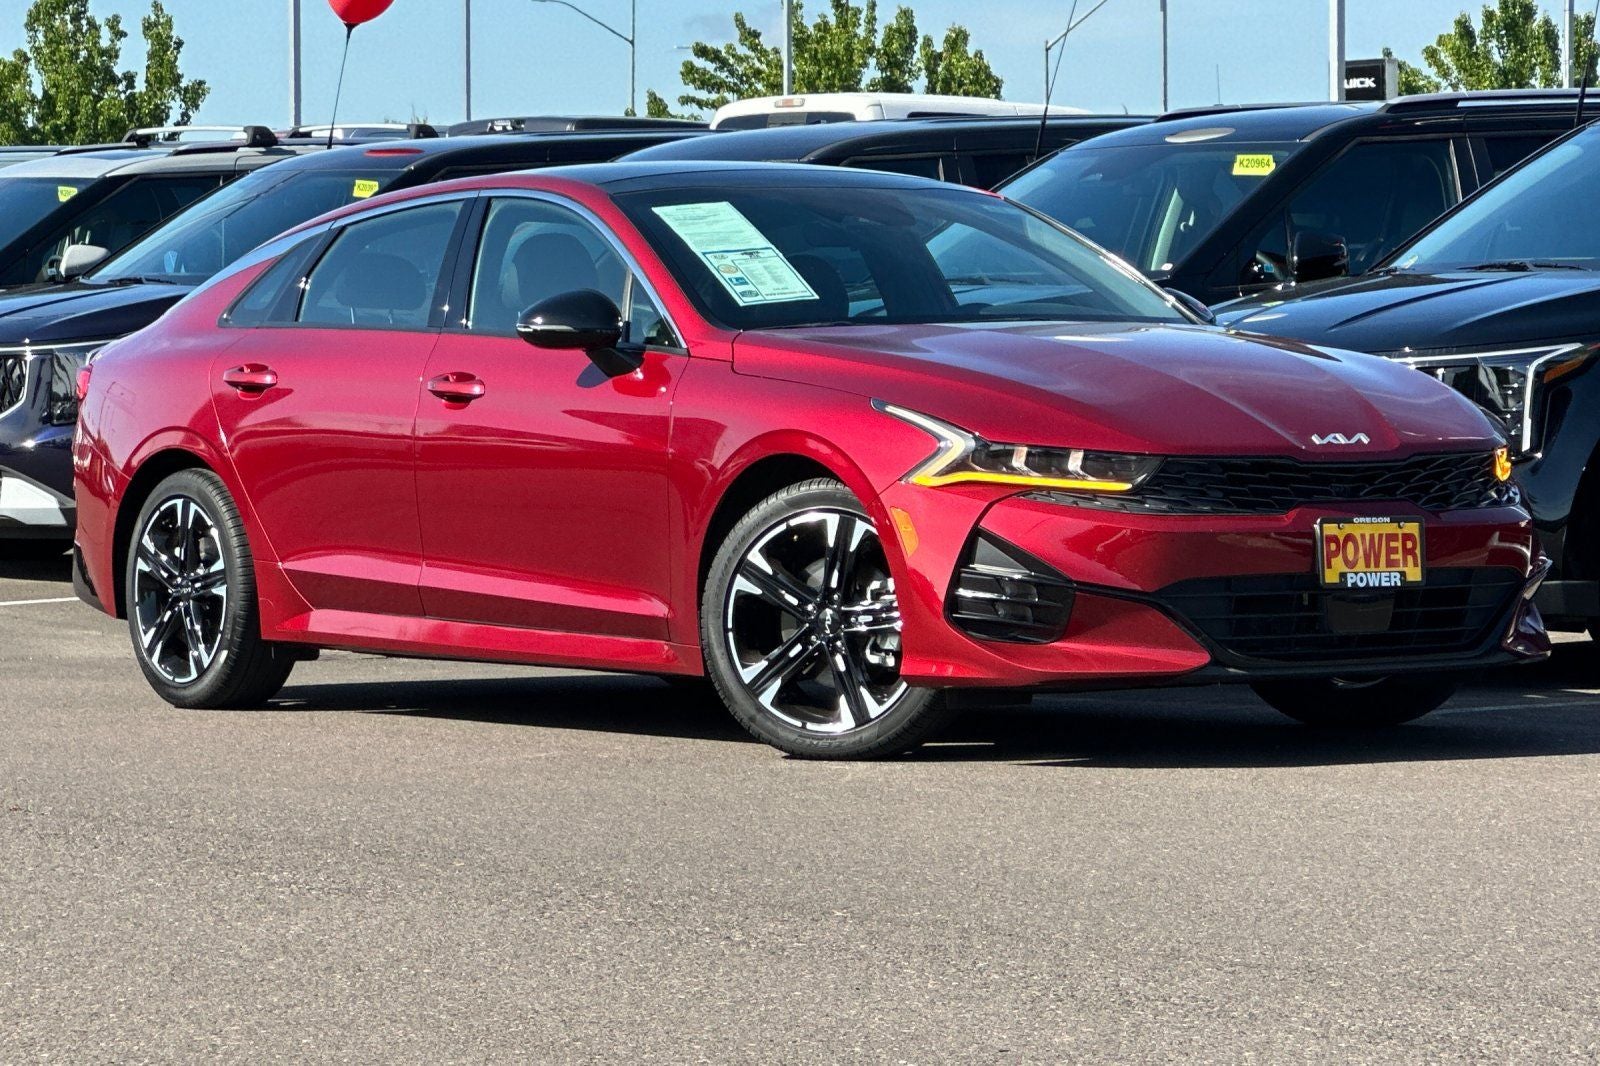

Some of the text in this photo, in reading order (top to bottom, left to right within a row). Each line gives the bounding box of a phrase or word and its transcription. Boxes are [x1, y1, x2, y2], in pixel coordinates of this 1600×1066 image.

[1343, 77, 1376, 89] UICK
[1238, 158, 1271, 169] K20964
[1311, 432, 1370, 445] KIA
[1324, 532, 1419, 570] POWER
[1346, 572, 1401, 588] POWER
